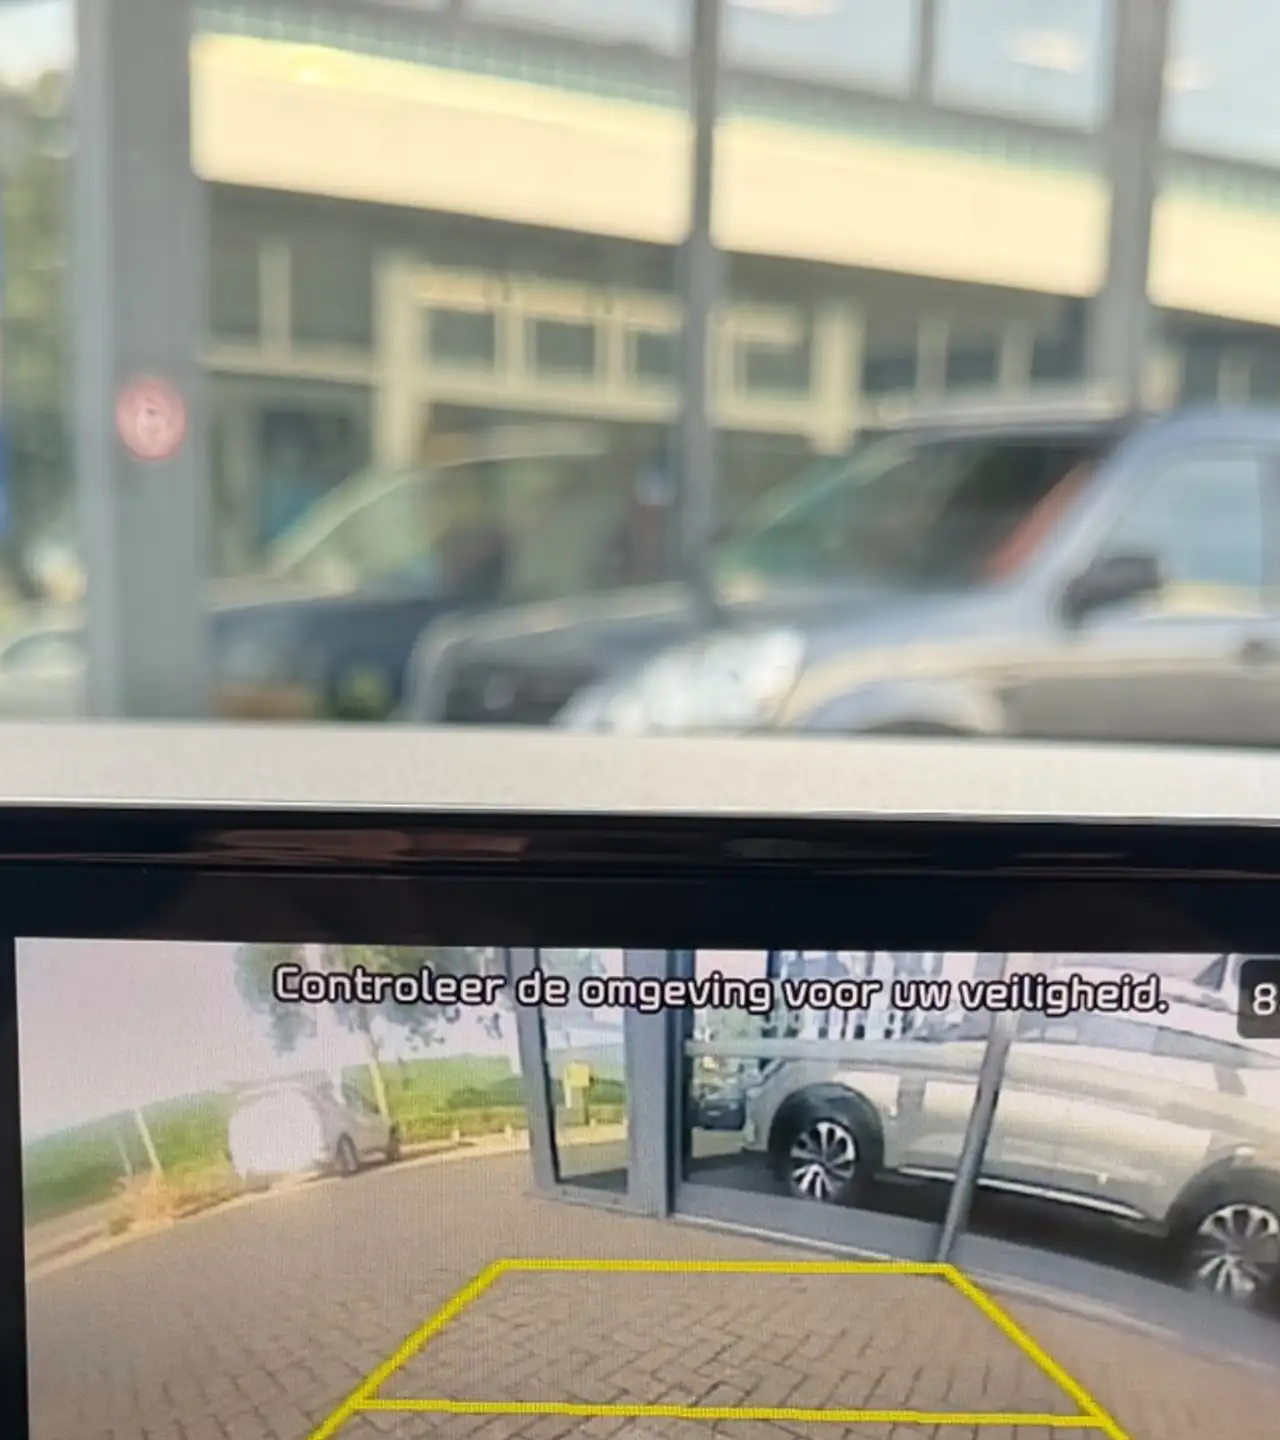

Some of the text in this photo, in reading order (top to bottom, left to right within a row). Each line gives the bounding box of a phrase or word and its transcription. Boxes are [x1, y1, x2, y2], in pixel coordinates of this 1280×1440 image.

[276, 965, 1168, 1016] Controleer de omgeving voor uw veiligheid.
